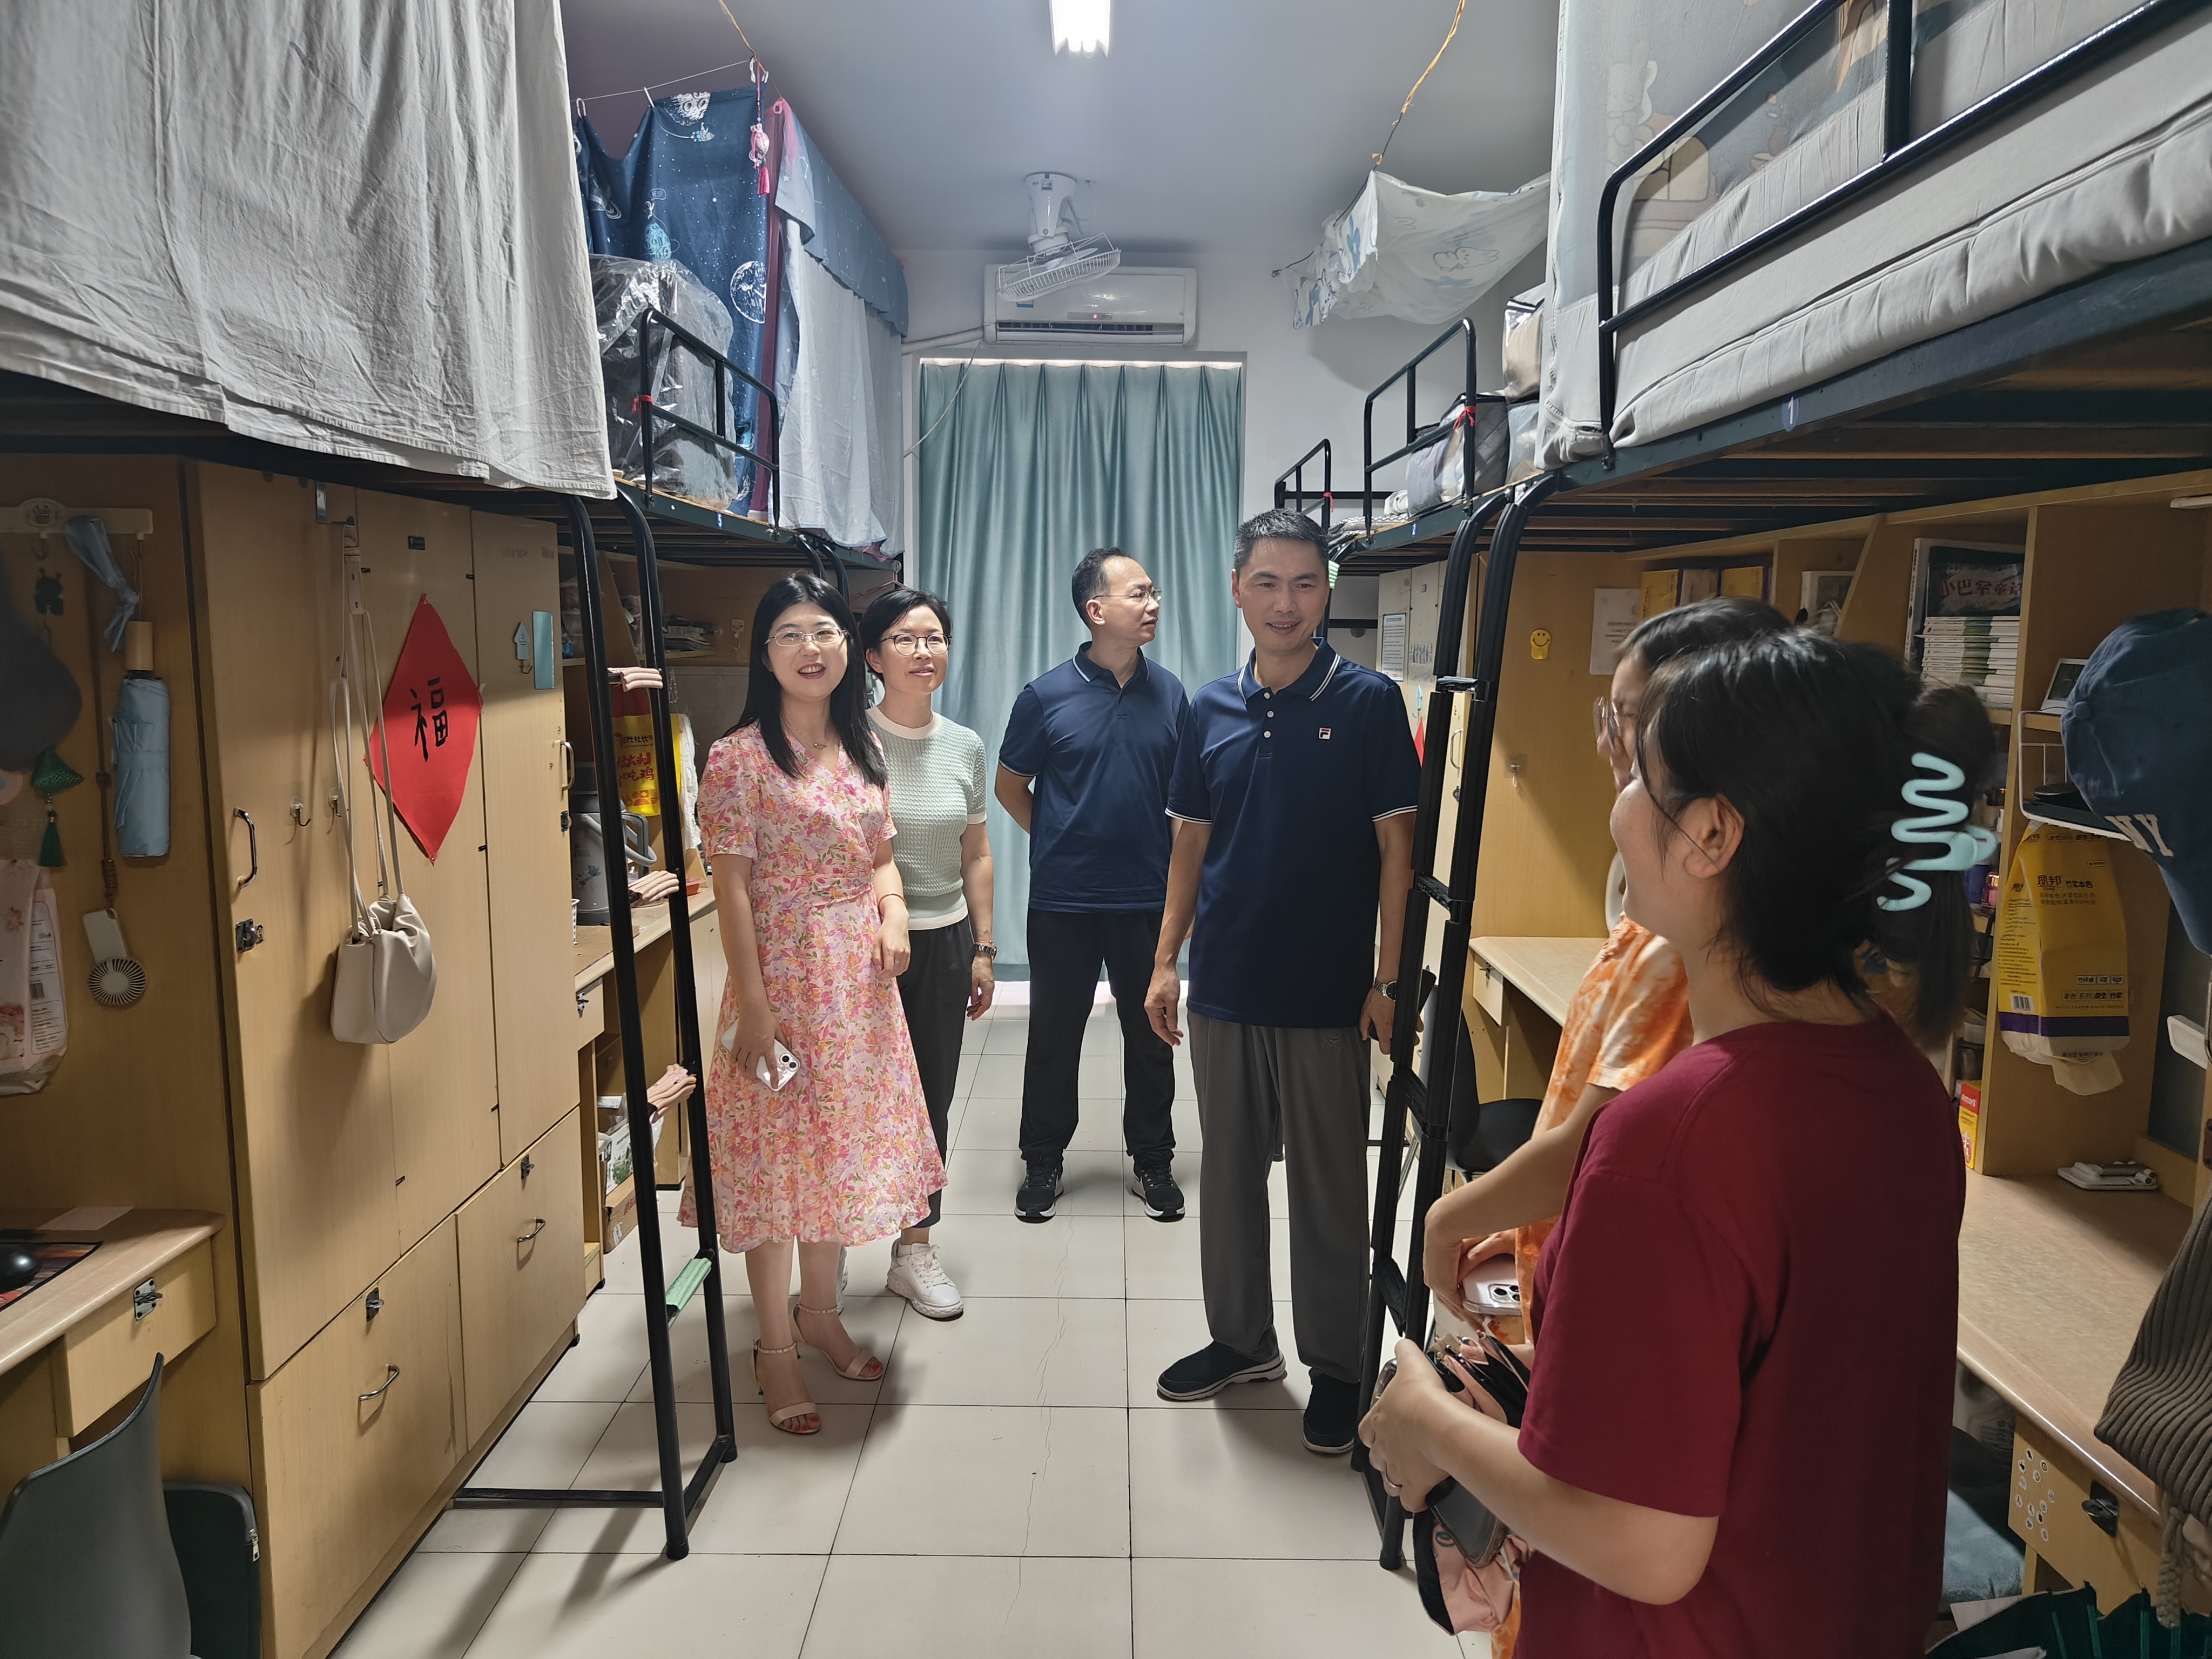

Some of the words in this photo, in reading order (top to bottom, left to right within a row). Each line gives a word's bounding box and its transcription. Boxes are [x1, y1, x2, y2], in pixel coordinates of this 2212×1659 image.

[1788, 396, 1794, 425] 1
[410, 677, 448, 762] 福
[2105, 814, 2174, 857] NY
[2036, 875, 2061, 886] 丽邦
